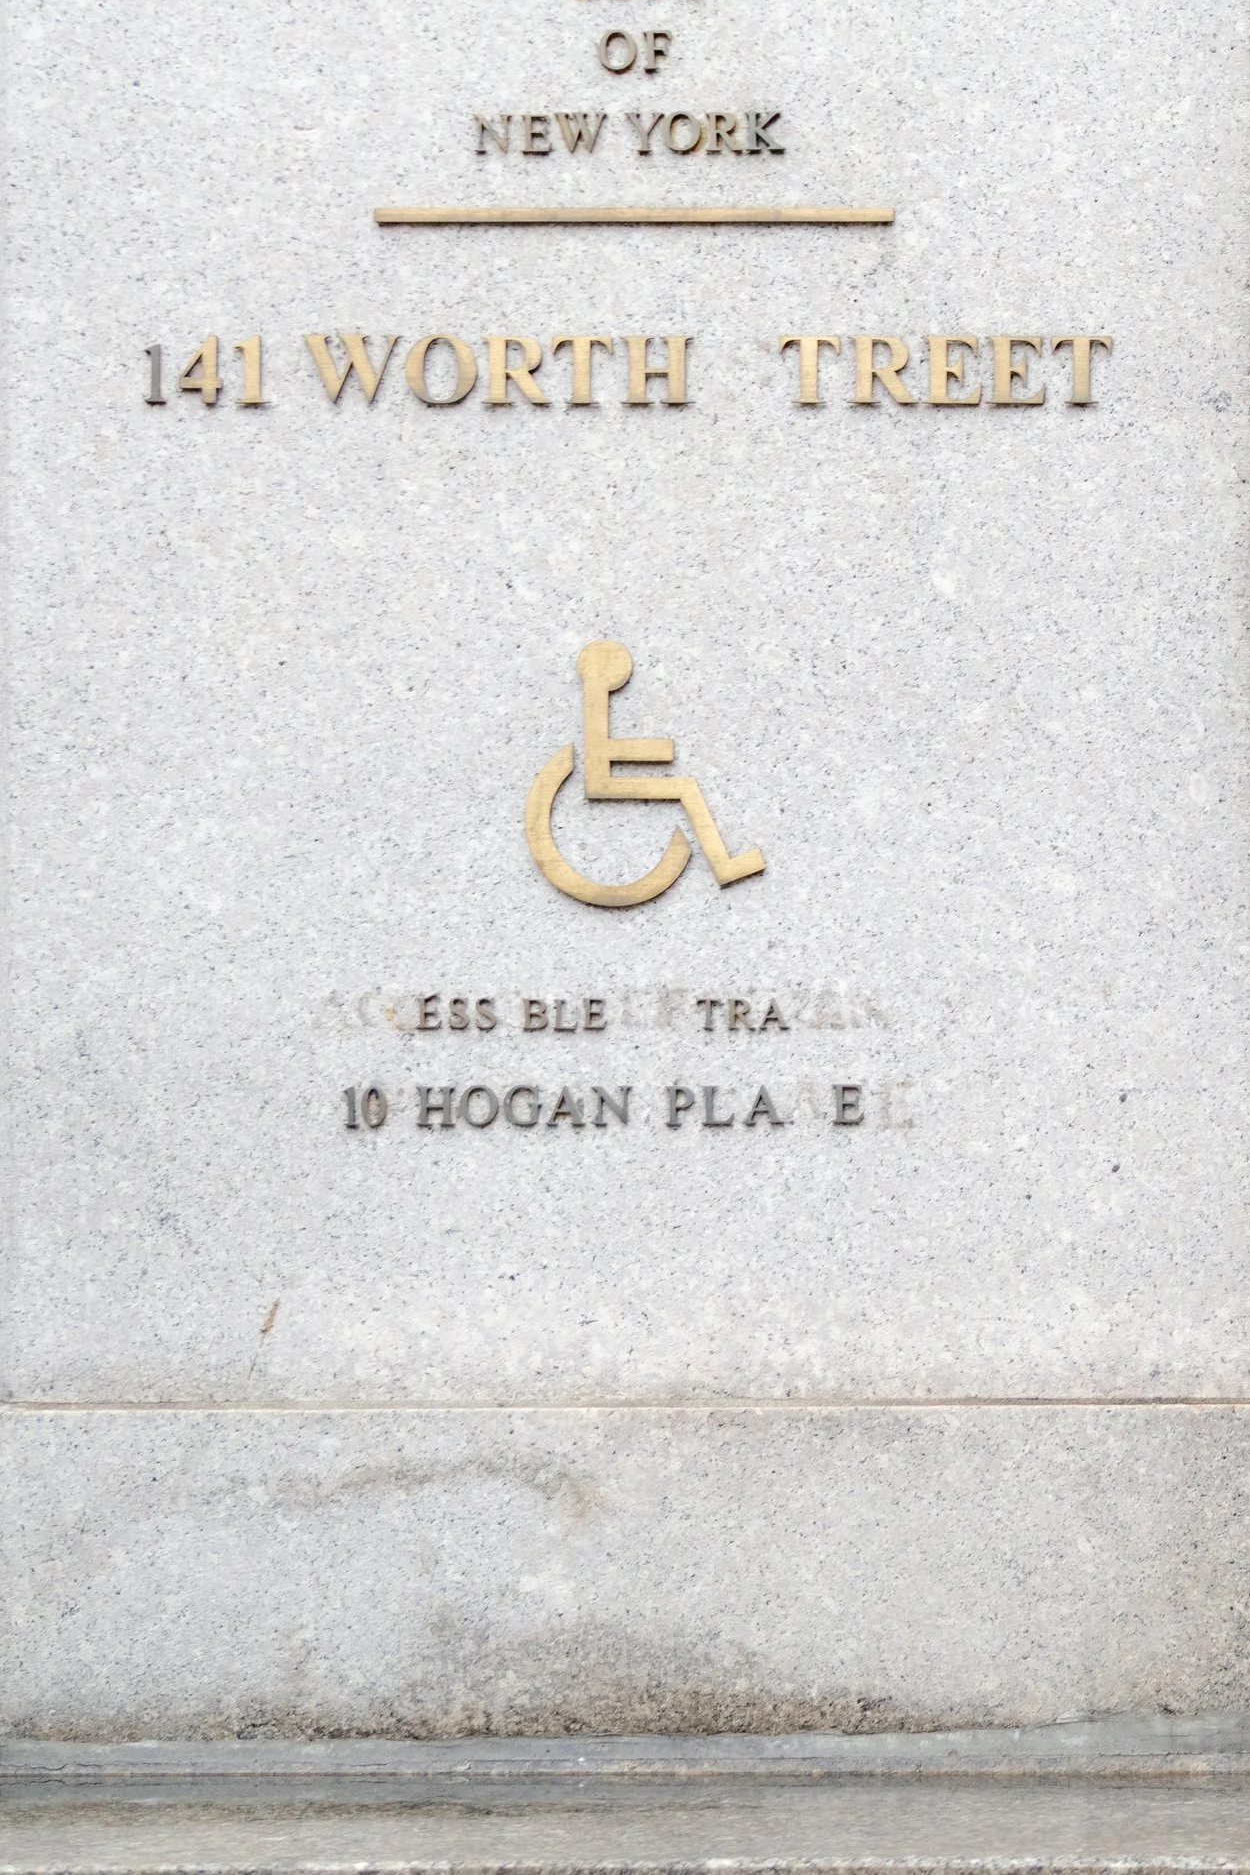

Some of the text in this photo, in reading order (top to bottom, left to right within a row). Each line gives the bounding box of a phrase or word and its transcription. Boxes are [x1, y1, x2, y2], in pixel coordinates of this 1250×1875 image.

[598, 30, 674, 75] OF
[475, 111, 787, 156] NEW YORK
[144, 333, 1114, 408] 141 WORTH TREET
[343, 1083, 864, 1130] 10 HOGAN PLAE
